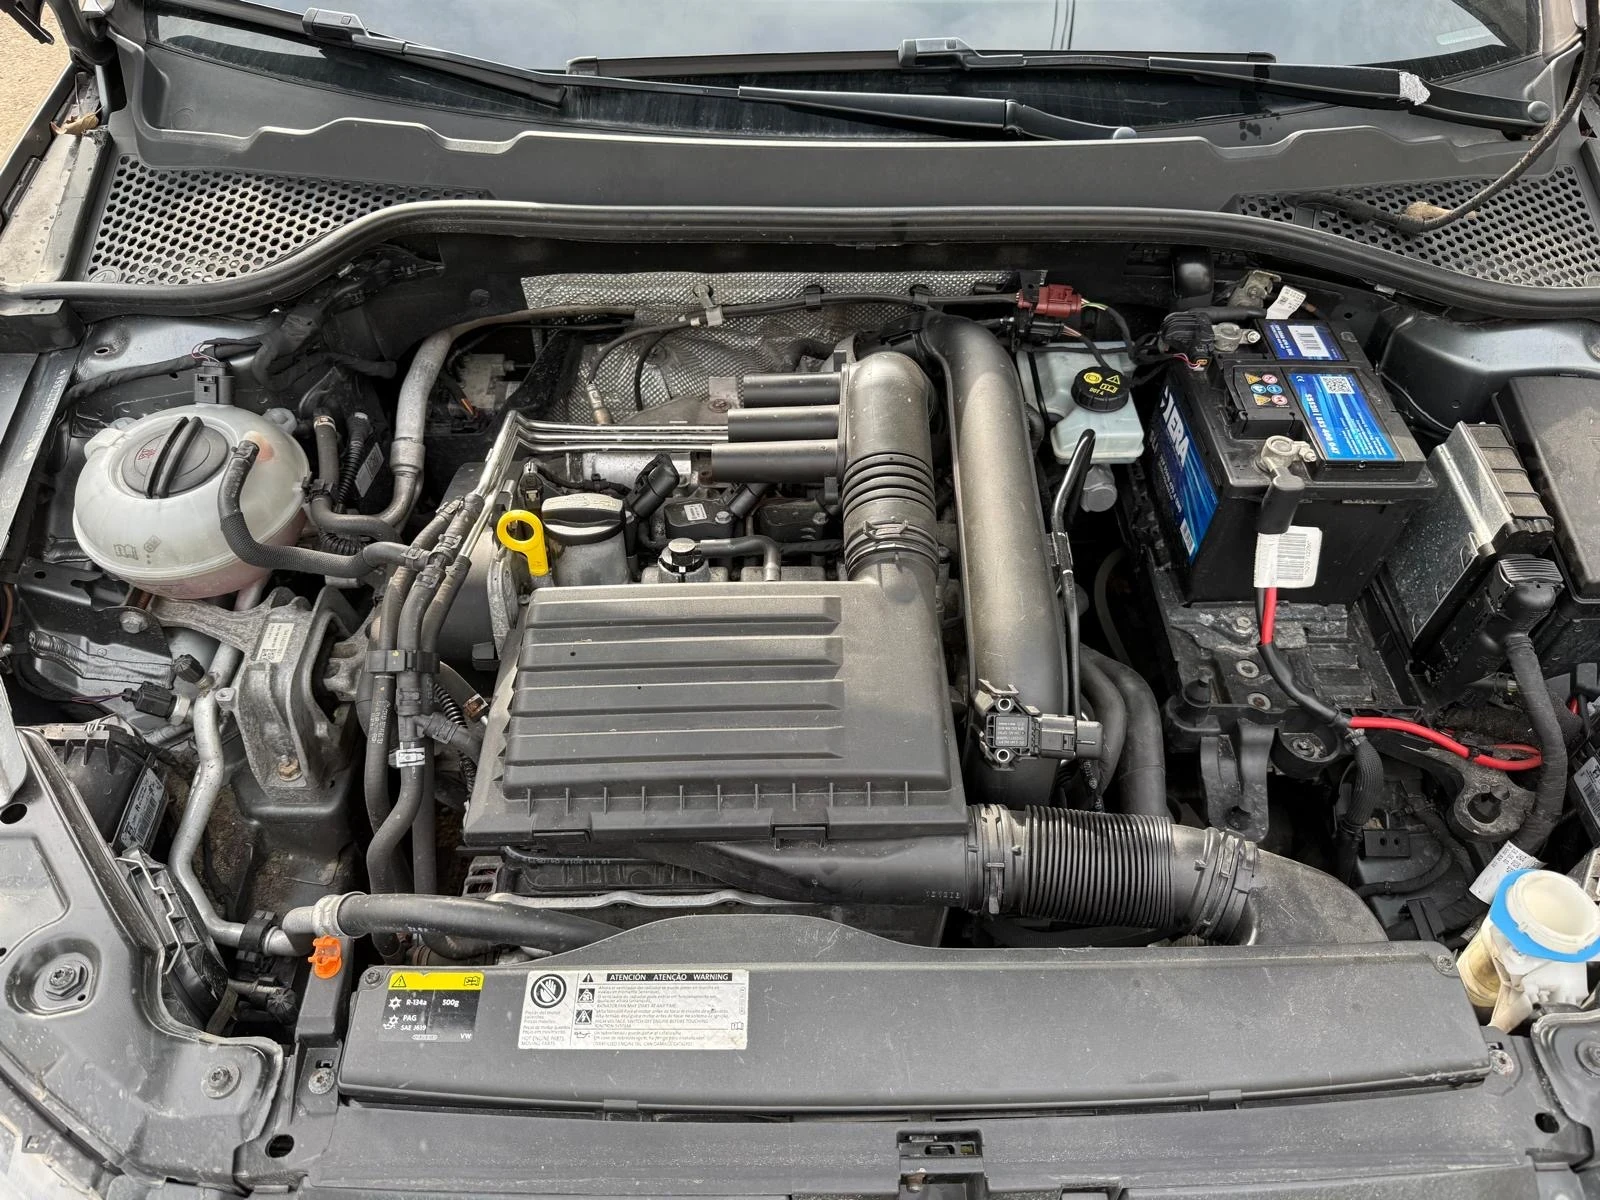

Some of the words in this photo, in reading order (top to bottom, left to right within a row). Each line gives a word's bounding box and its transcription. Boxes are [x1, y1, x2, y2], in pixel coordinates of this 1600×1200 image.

[610, 972, 647, 981] ATENCIÓN
[653, 972, 687, 982] ATENÇÃO
[693, 972, 729, 981] WARNING
[406, 998, 428, 1006] R-134a
[442, 998, 460, 1008] 500g
